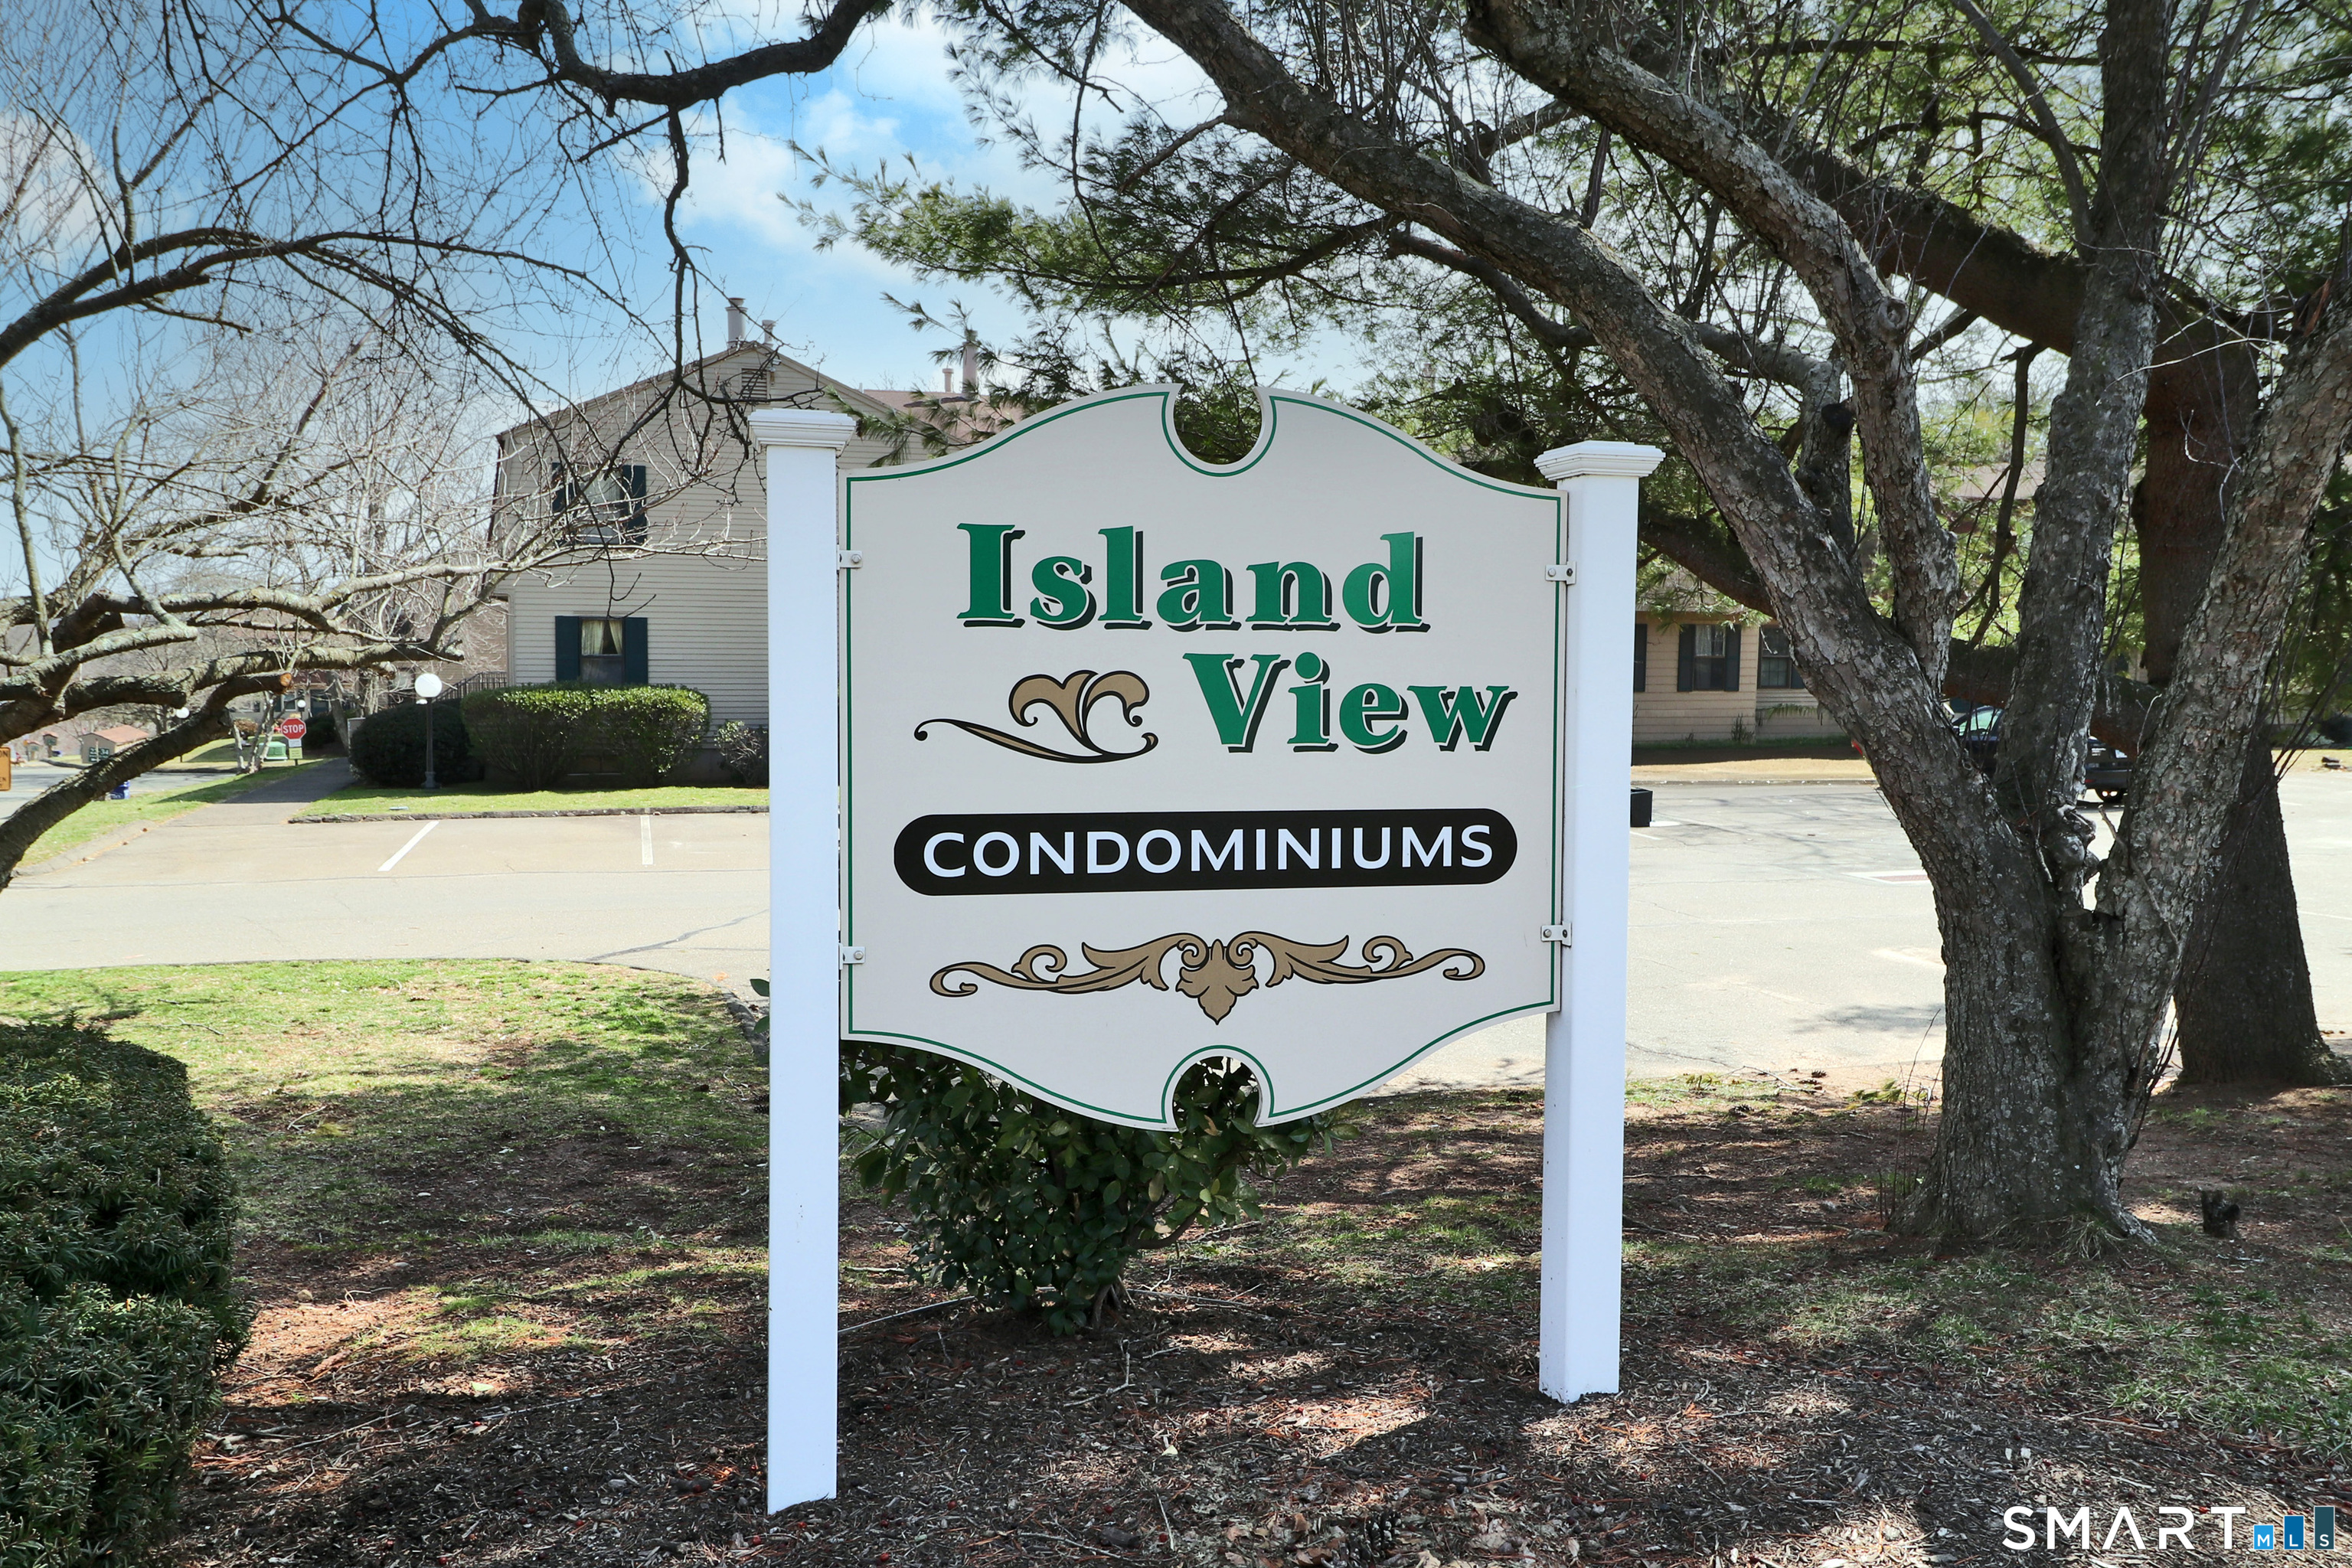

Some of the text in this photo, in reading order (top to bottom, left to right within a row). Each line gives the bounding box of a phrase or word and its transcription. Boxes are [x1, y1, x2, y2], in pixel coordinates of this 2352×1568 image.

[956, 523, 1431, 633] Island
[283, 724, 304, 733] STOP
[1182, 651, 1518, 754] View
[923, 824, 1494, 879] CONDOMINIUMS
